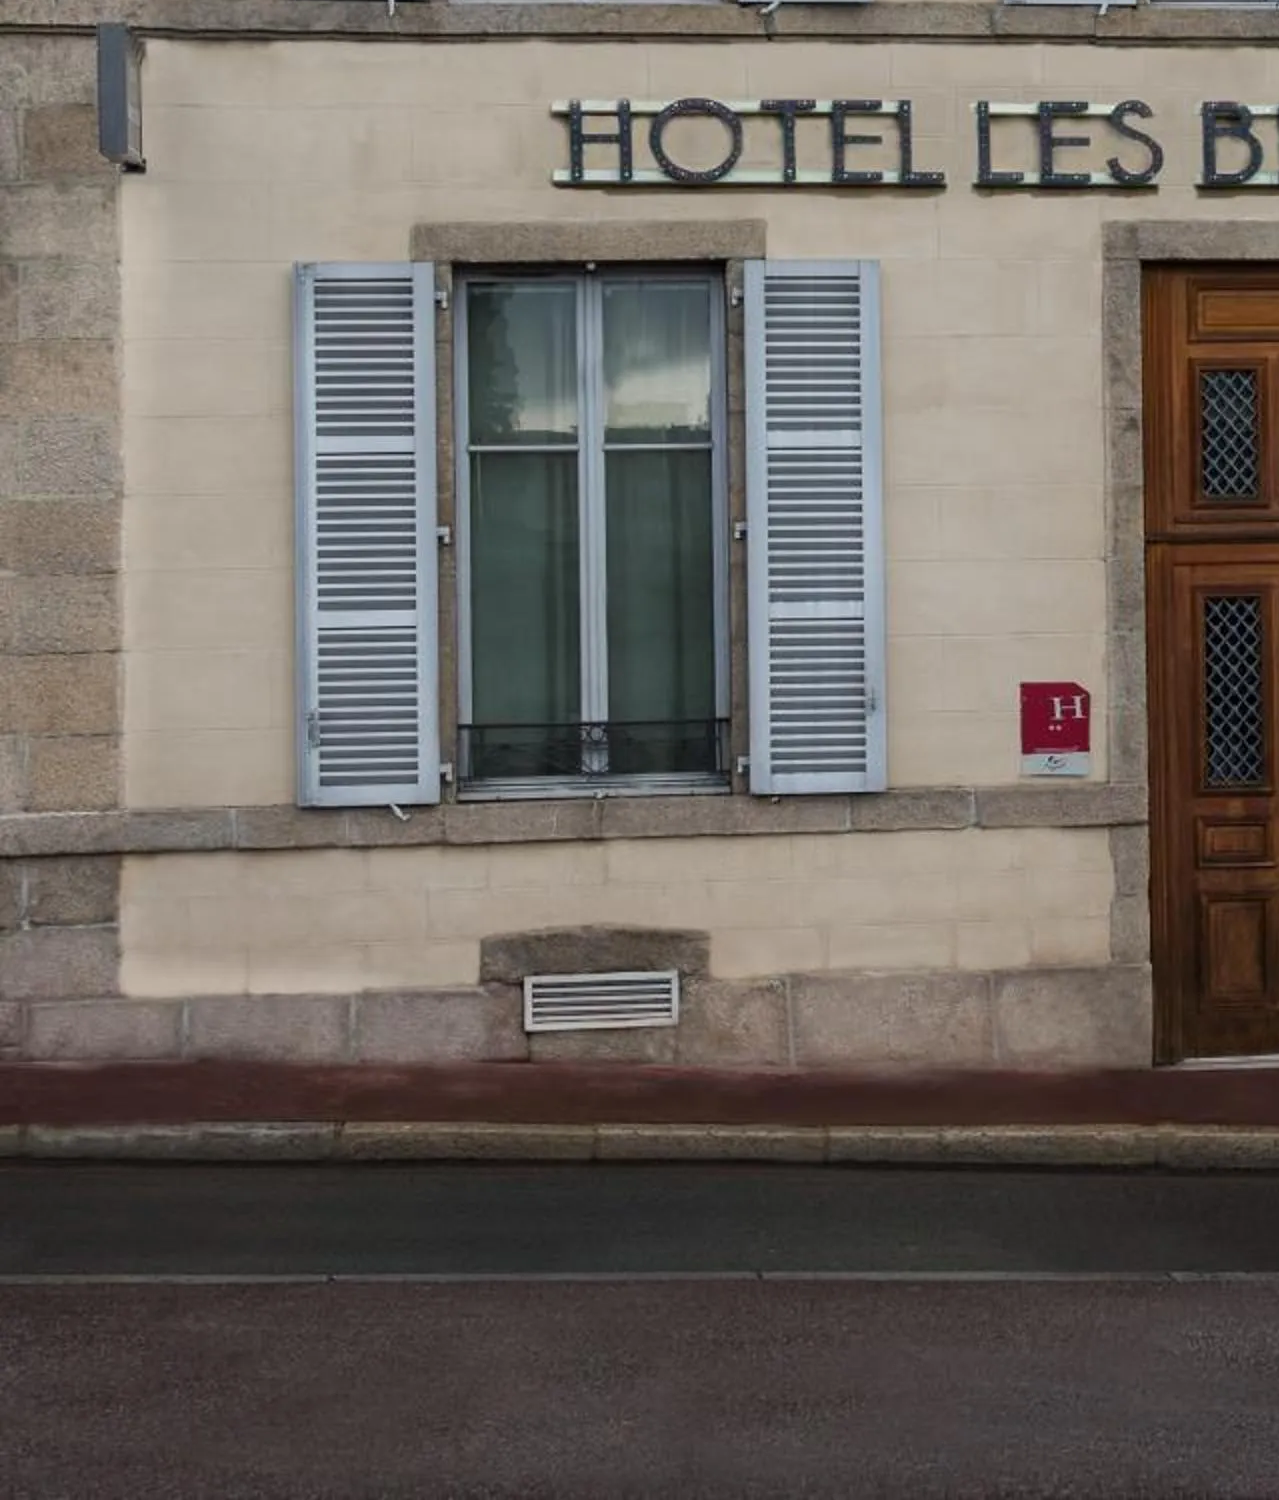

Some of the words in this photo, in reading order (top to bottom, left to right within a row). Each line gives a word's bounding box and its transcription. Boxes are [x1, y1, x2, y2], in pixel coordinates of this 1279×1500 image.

[568, 98, 946, 184] HOTEL
[976, 99, 1164, 185] LES
[1049, 695, 1087, 720] H
